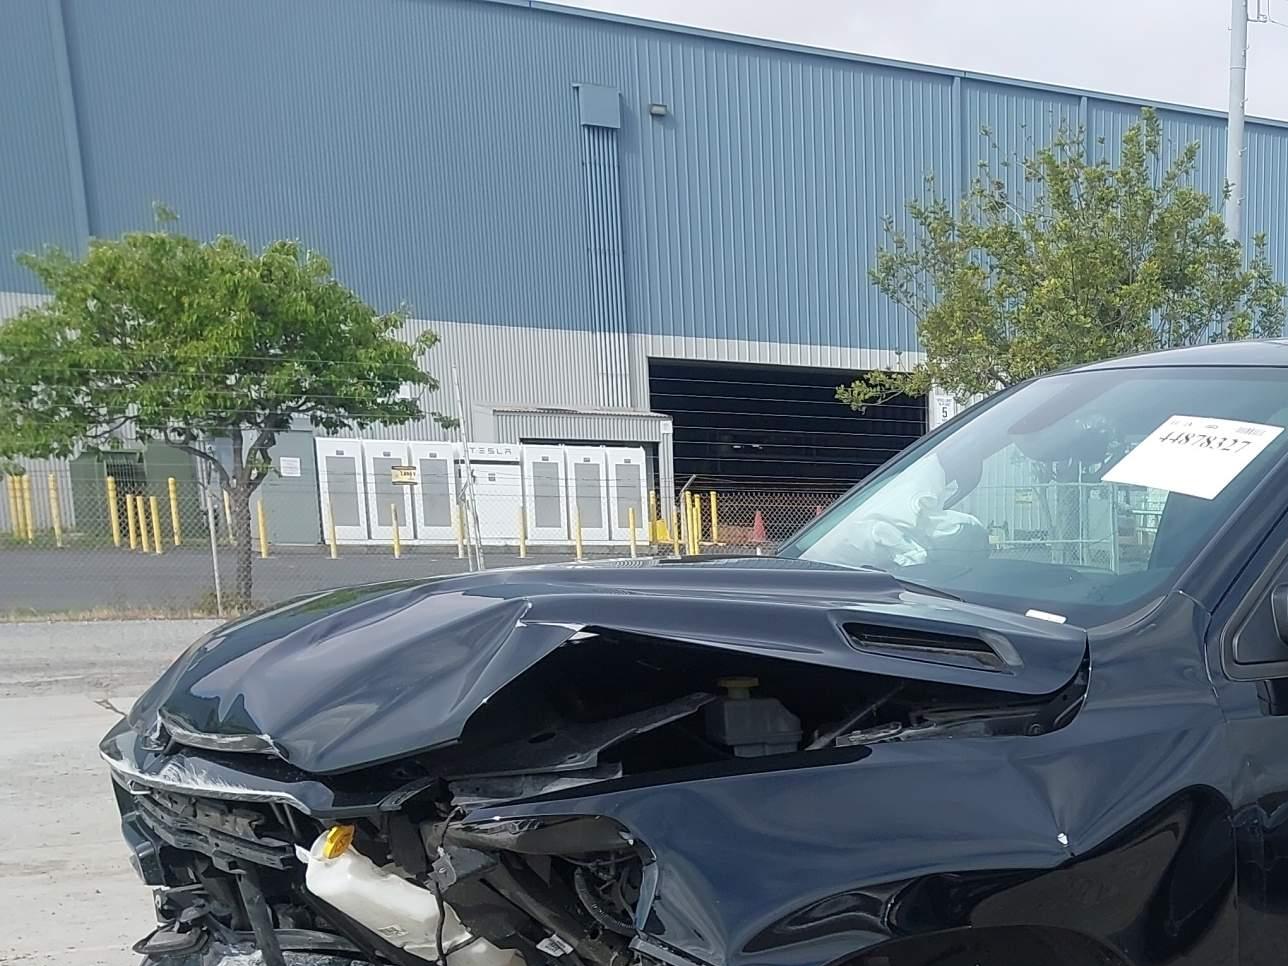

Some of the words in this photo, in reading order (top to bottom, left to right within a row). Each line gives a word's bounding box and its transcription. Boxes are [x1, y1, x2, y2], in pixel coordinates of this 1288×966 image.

[942, 406, 948, 418] 5
[1159, 431, 1253, 453] 44878327
[469, 446, 512, 456] TESLA
